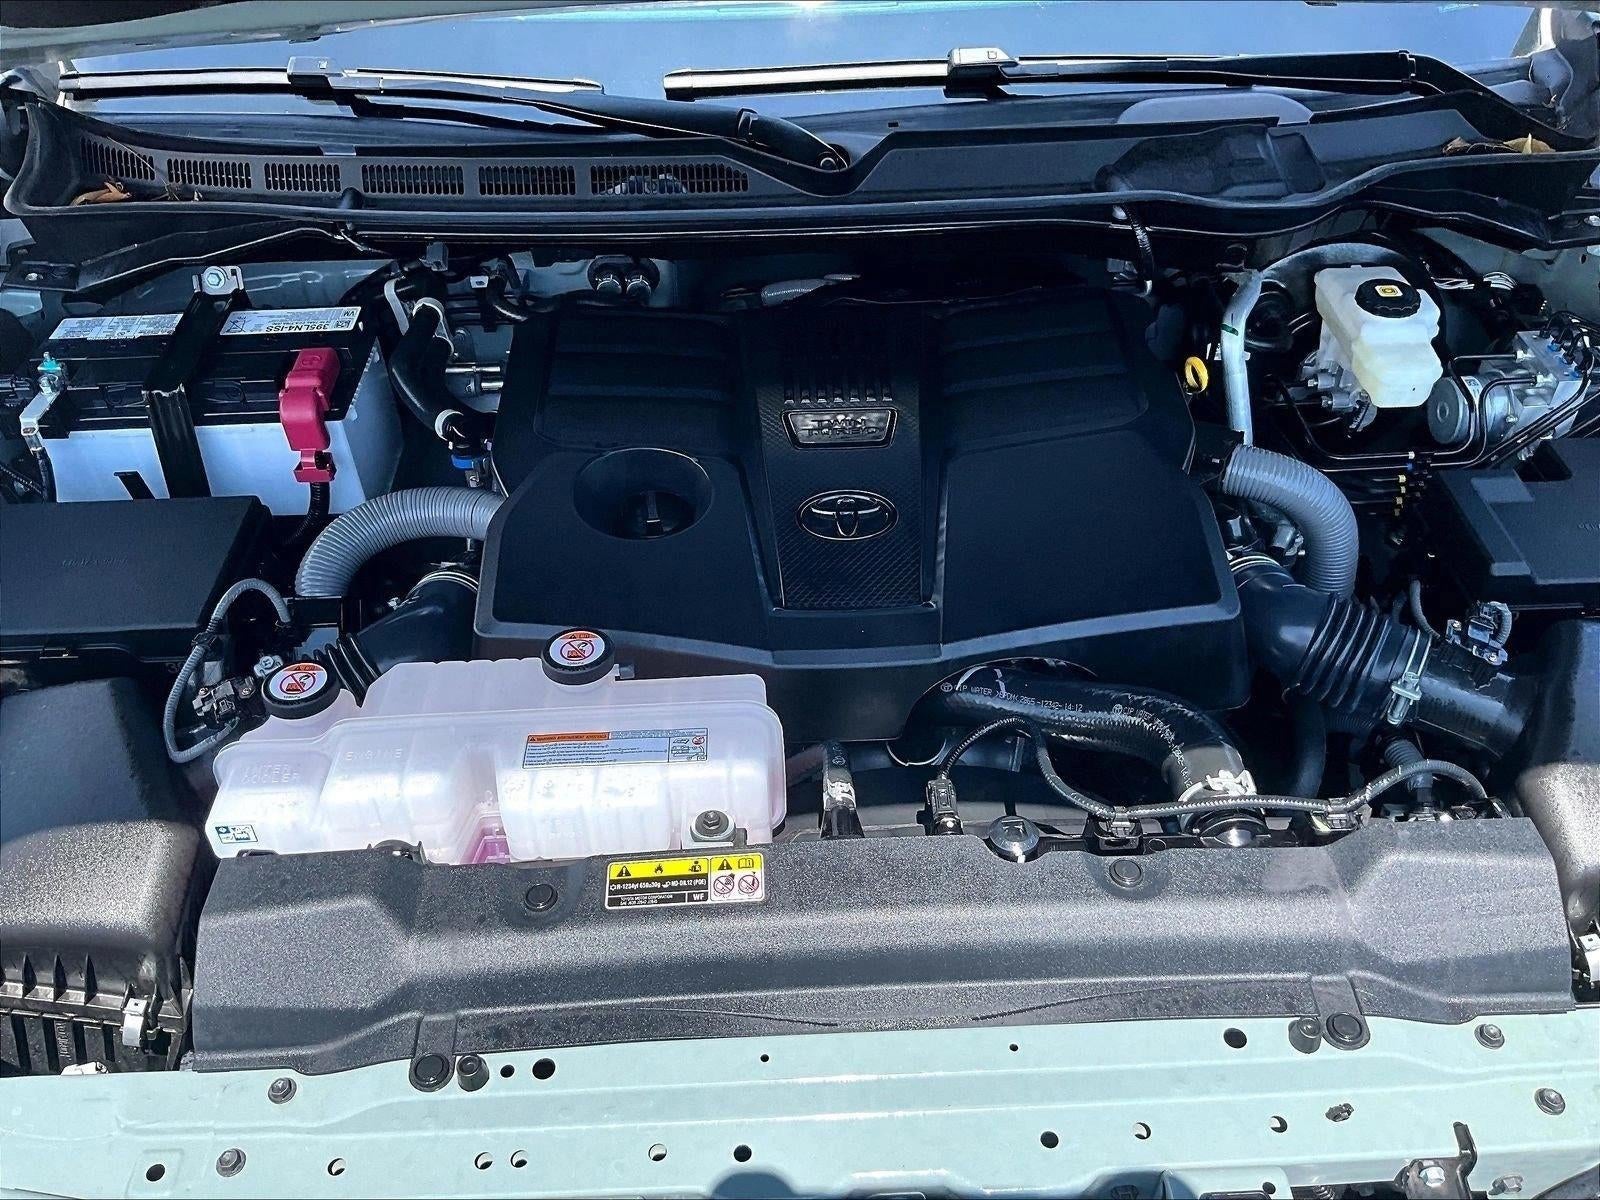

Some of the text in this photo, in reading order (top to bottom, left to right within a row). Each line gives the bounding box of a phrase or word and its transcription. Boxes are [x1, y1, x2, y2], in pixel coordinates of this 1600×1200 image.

[265, 324, 329, 332] 395LN4-ISS
[811, 418, 867, 428] TWIN
[970, 686, 993, 696] WATER
[692, 893, 705, 901] WF
